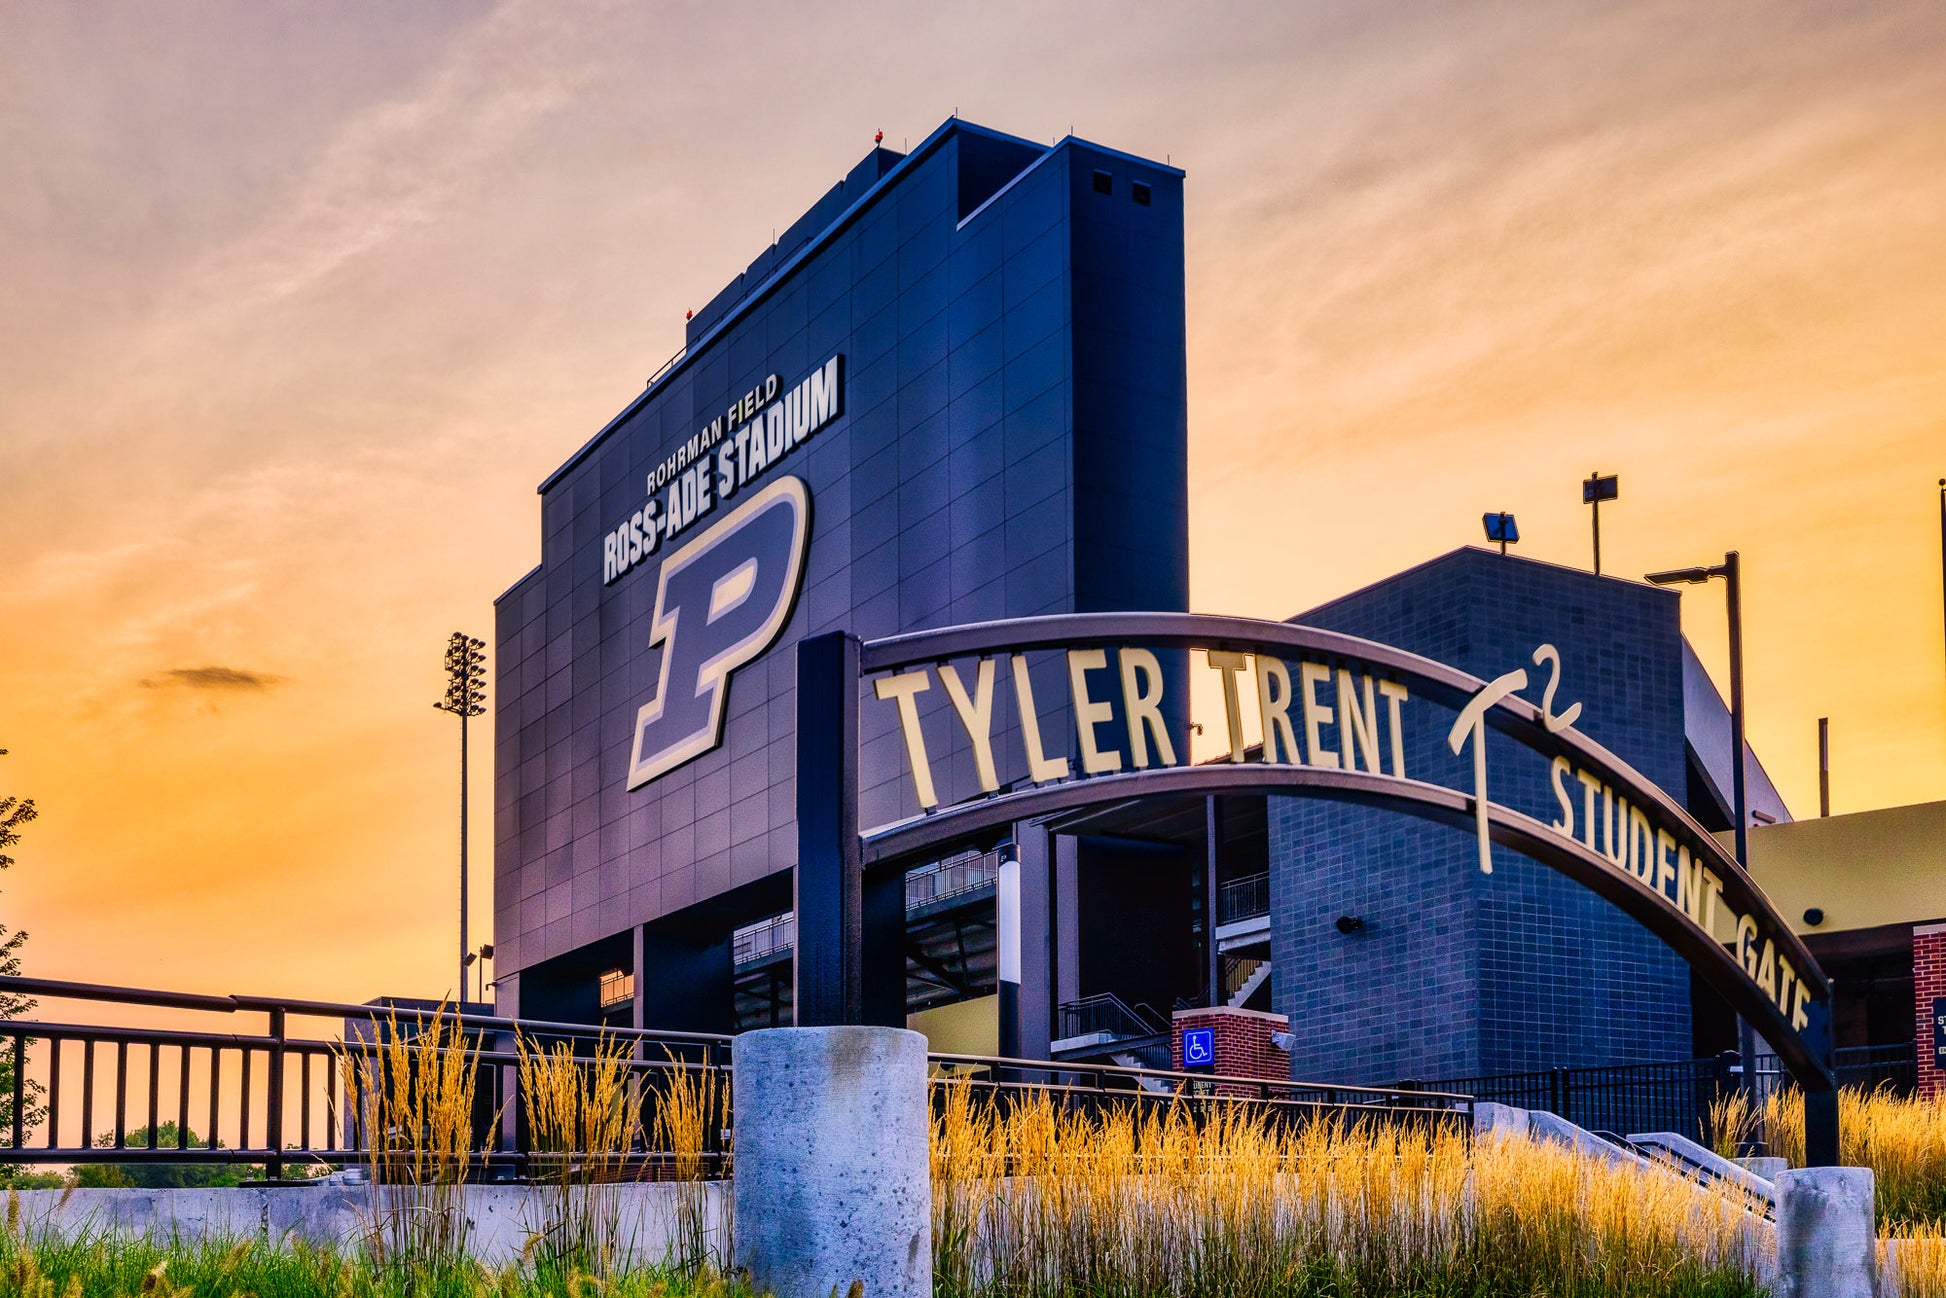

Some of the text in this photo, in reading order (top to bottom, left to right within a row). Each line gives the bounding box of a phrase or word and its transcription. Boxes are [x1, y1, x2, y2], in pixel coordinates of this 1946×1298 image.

[604, 354, 838, 585] ROSS-ADE STADIUM
[647, 373, 777, 496] ROHRMAN FIELD
[626, 475, 808, 792] P
[874, 647, 1408, 809] TYLER TRENT
[1552, 755, 1811, 1033] STUDENT GATE
